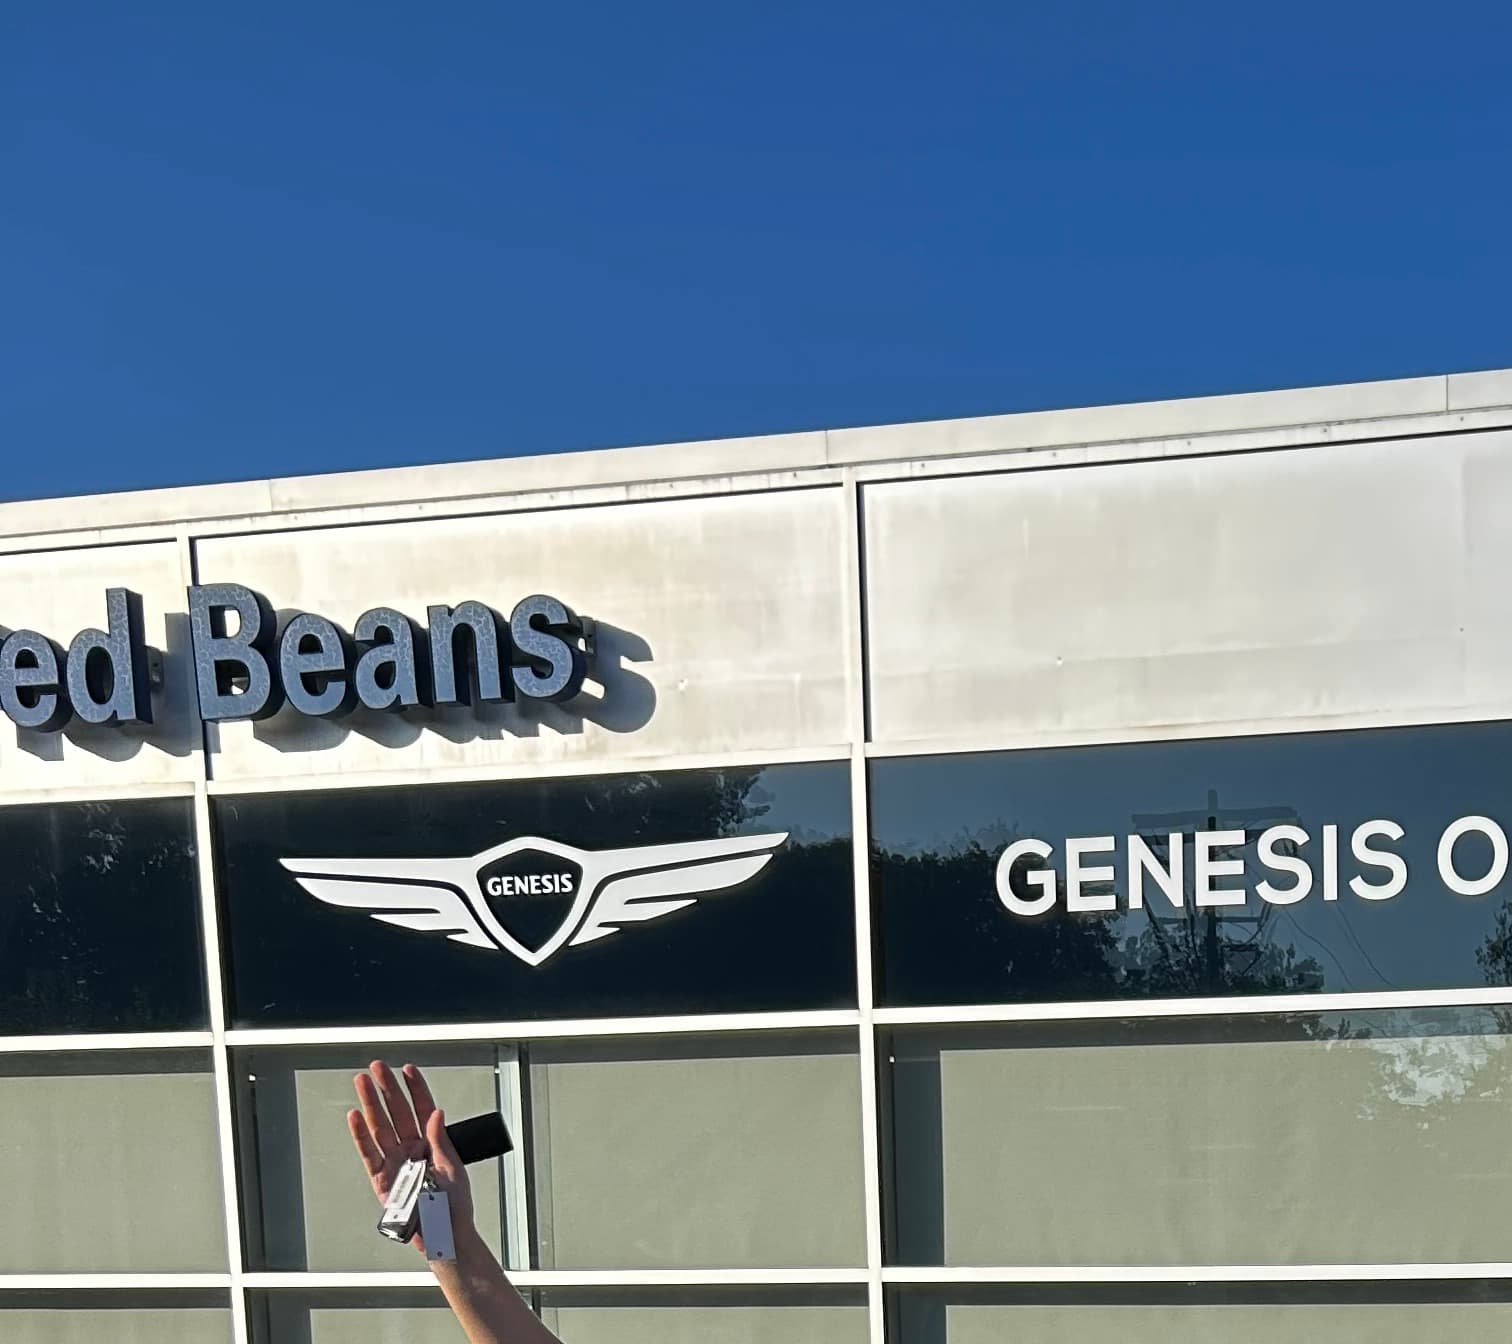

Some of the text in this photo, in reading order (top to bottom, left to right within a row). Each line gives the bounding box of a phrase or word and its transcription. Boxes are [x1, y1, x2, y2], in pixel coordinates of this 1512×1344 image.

[188, 583, 594, 721] Beans
[486, 872, 575, 898] GENESIS
[995, 818, 1408, 917] GENESIS
